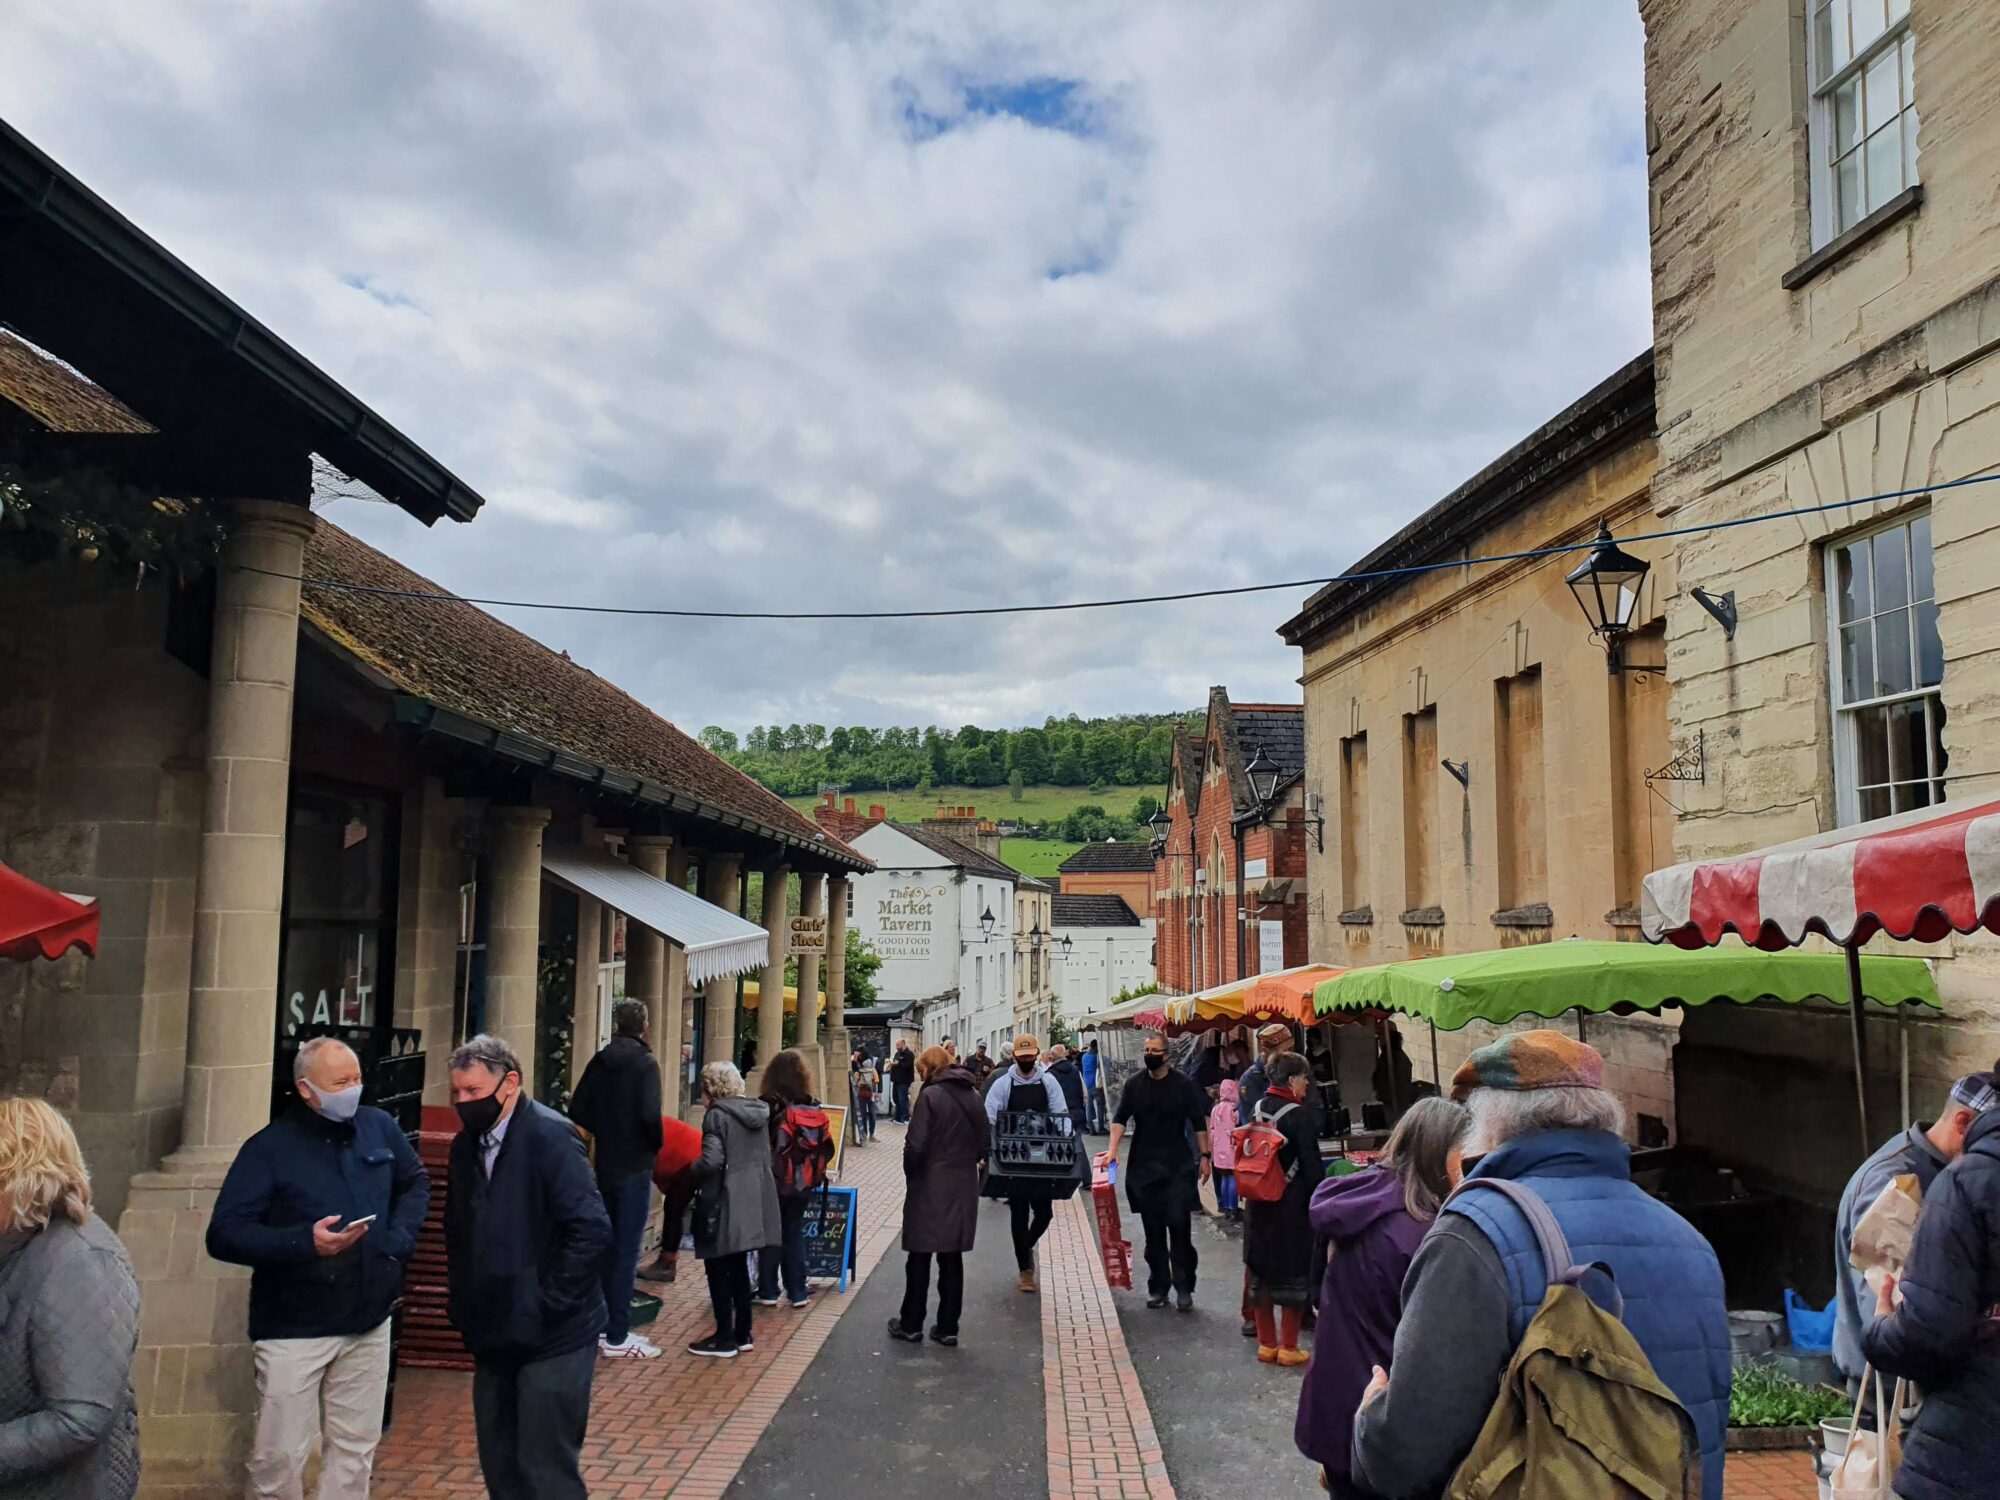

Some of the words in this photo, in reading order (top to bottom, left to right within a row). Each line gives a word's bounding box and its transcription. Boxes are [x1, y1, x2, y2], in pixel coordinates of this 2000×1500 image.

[877, 900, 933, 915] Market
[879, 916, 932, 931] Tavern
[791, 933, 825, 947] Shed
[877, 937, 904, 945] GOOD
[905, 937, 930, 945] FOOD
[886, 947, 907, 955] REAL
[910, 947, 930, 955] ALES
[287, 985, 373, 1036] SALT
